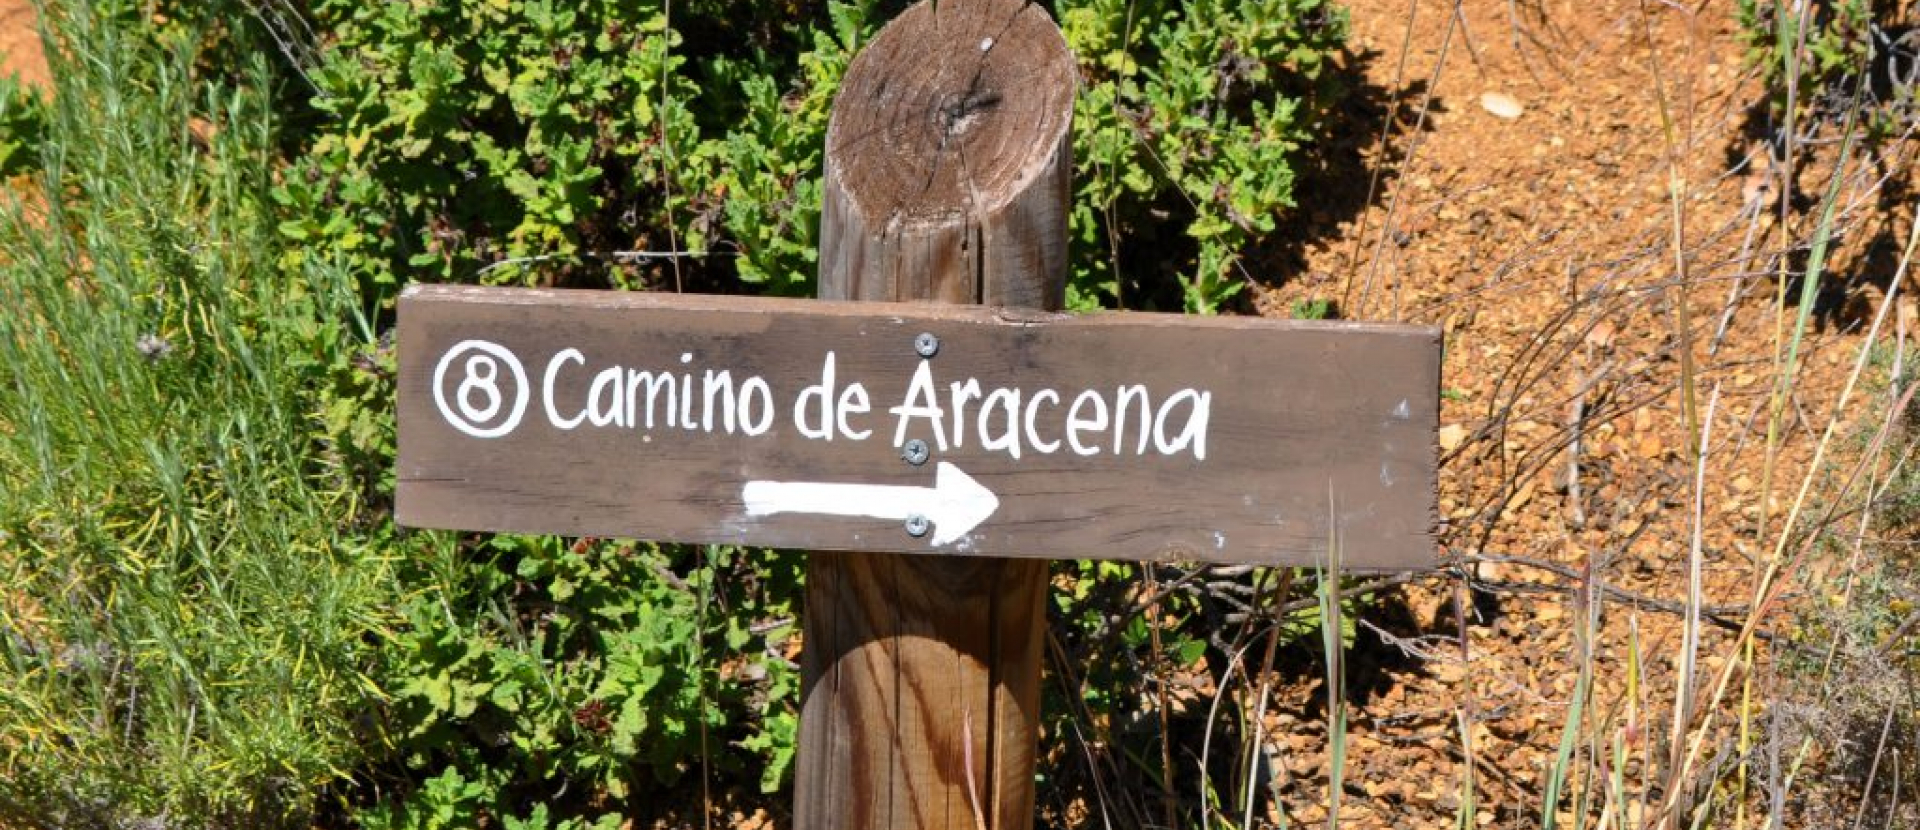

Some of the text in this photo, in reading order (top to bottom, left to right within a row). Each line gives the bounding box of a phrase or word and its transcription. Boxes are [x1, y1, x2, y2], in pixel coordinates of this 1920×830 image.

[542, 347, 775, 437] Camino
[794, 350, 873, 442] de
[888, 358, 1212, 461] Aracena
